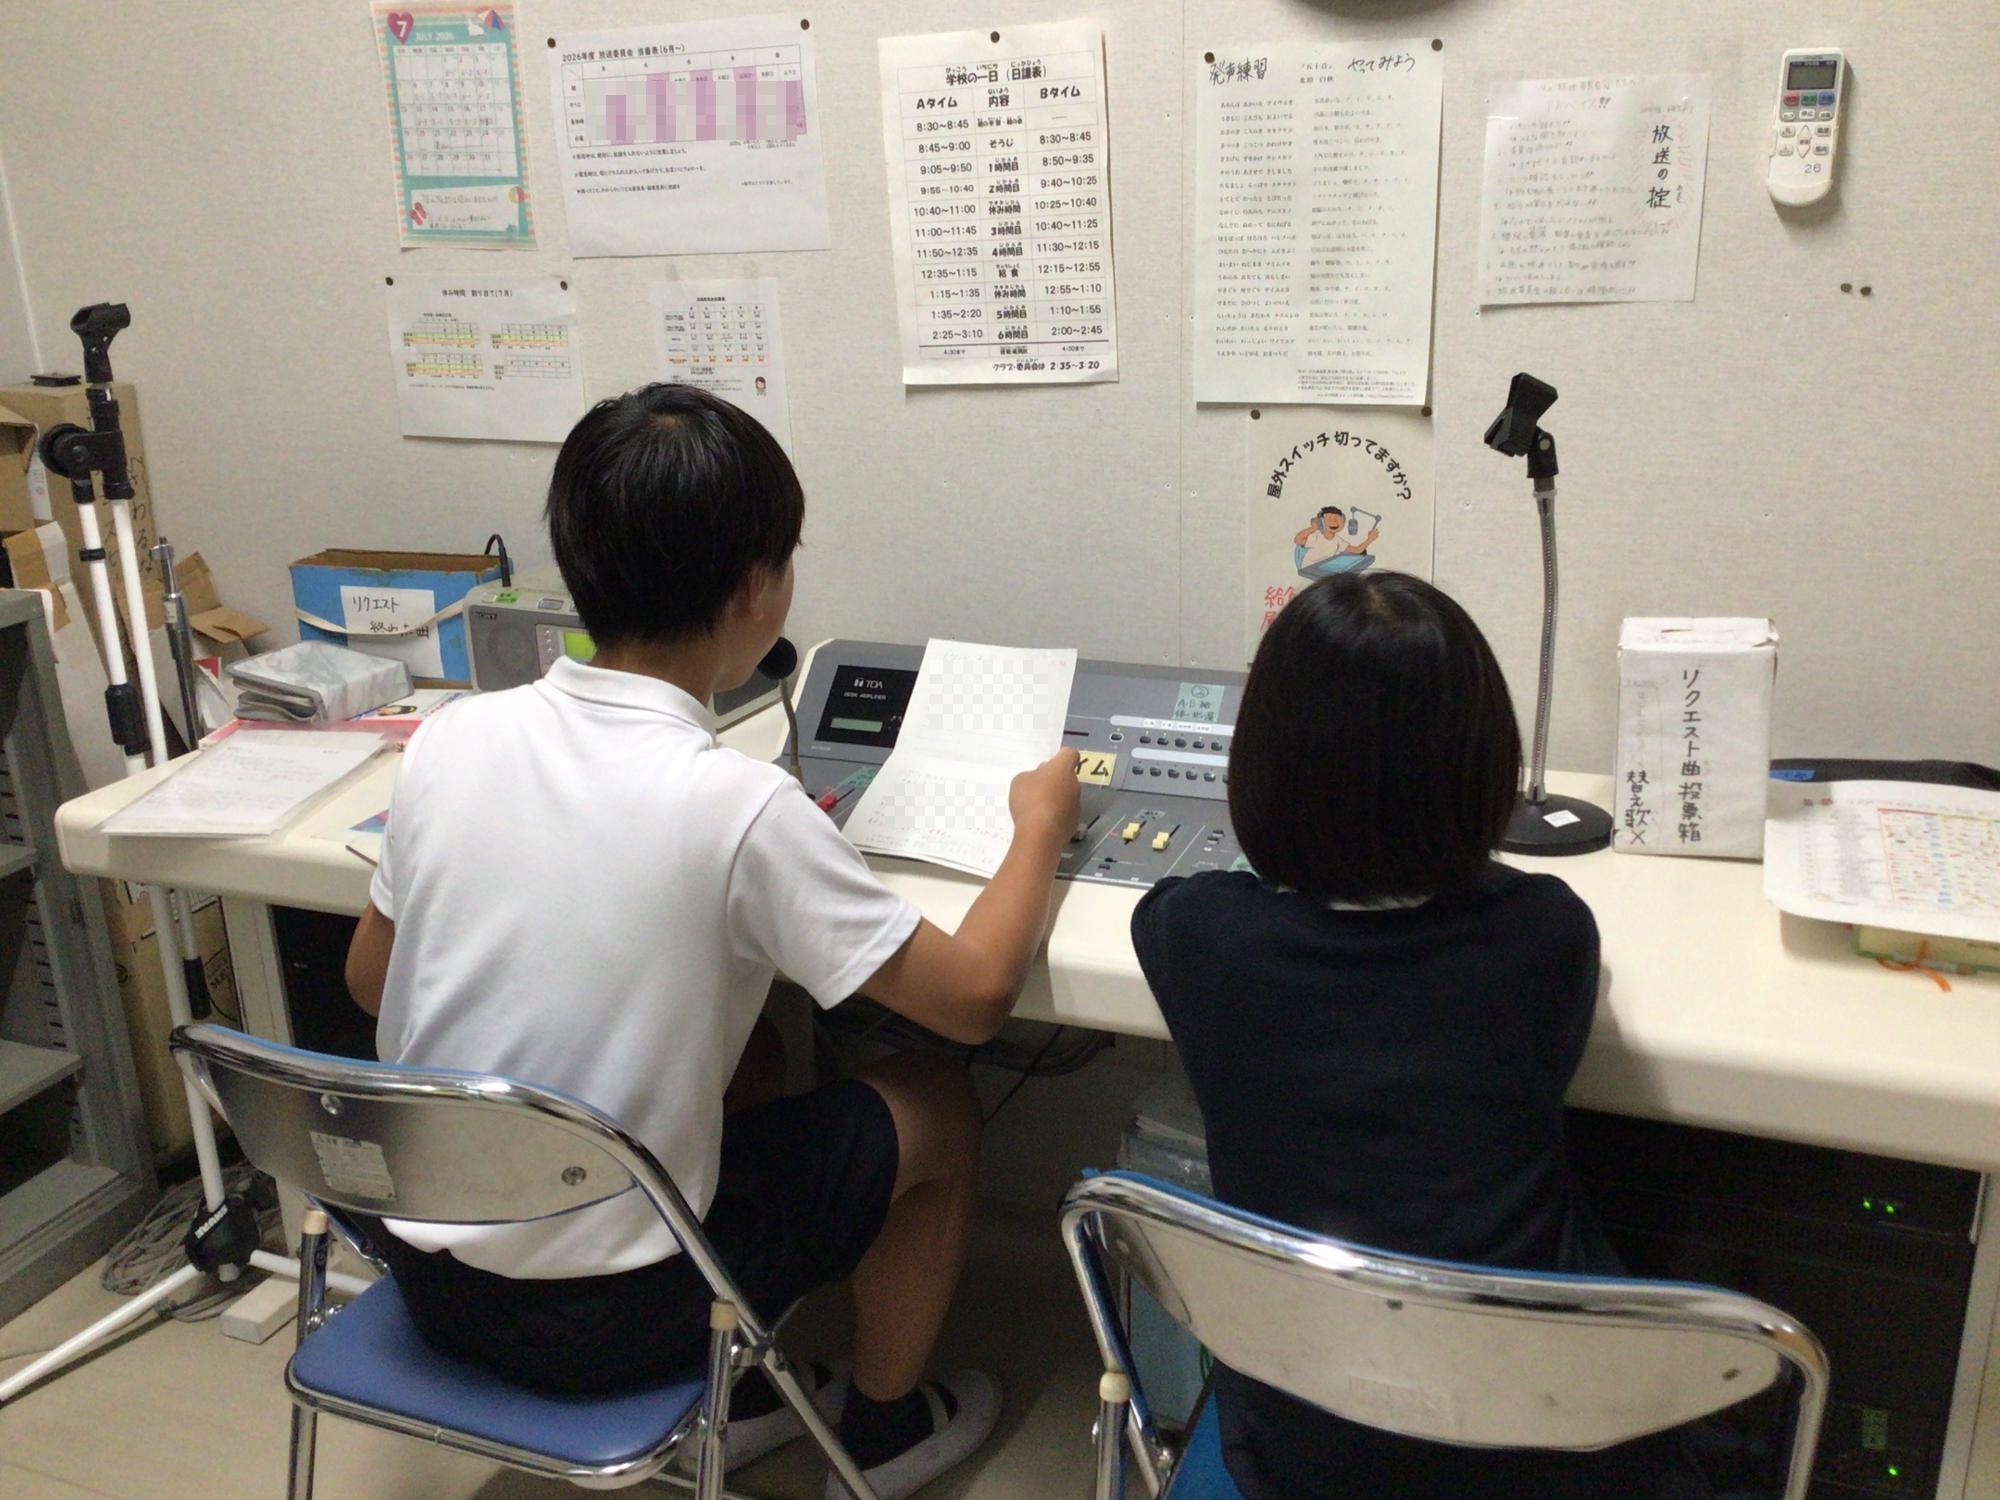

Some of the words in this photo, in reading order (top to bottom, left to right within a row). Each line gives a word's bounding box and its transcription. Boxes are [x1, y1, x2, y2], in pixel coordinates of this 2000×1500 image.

[397, 20, 407, 38] 7
[1347, 53, 1416, 74] やってみよう
[1209, 57, 1268, 86] 発声練習
[946, 70, 998, 86] 学校の一日
[917, 99, 958, 109] Aタイム
[989, 94, 1009, 107] 内容
[1040, 86, 1081, 99] Bタイム
[990, 138, 1013, 148] そうじ
[989, 162, 1018, 172] 1時間目
[1647, 124, 1674, 209] 放送の掟
[1805, 163, 1822, 174] 26
[989, 183, 1020, 193] 2時間目
[989, 205, 1021, 215] 休み時間
[991, 225, 1022, 236] 3時間目
[992, 247, 1023, 257] 4時間目
[994, 289, 1026, 298] 休み時間
[996, 309, 1027, 320] 5時間目
[998, 330, 1029, 340] 6時間目
[353, 596, 400, 613] リクエスト
[866, 680, 883, 688] TOA
[1678, 669, 1703, 844] リクエスト曲投票箱
